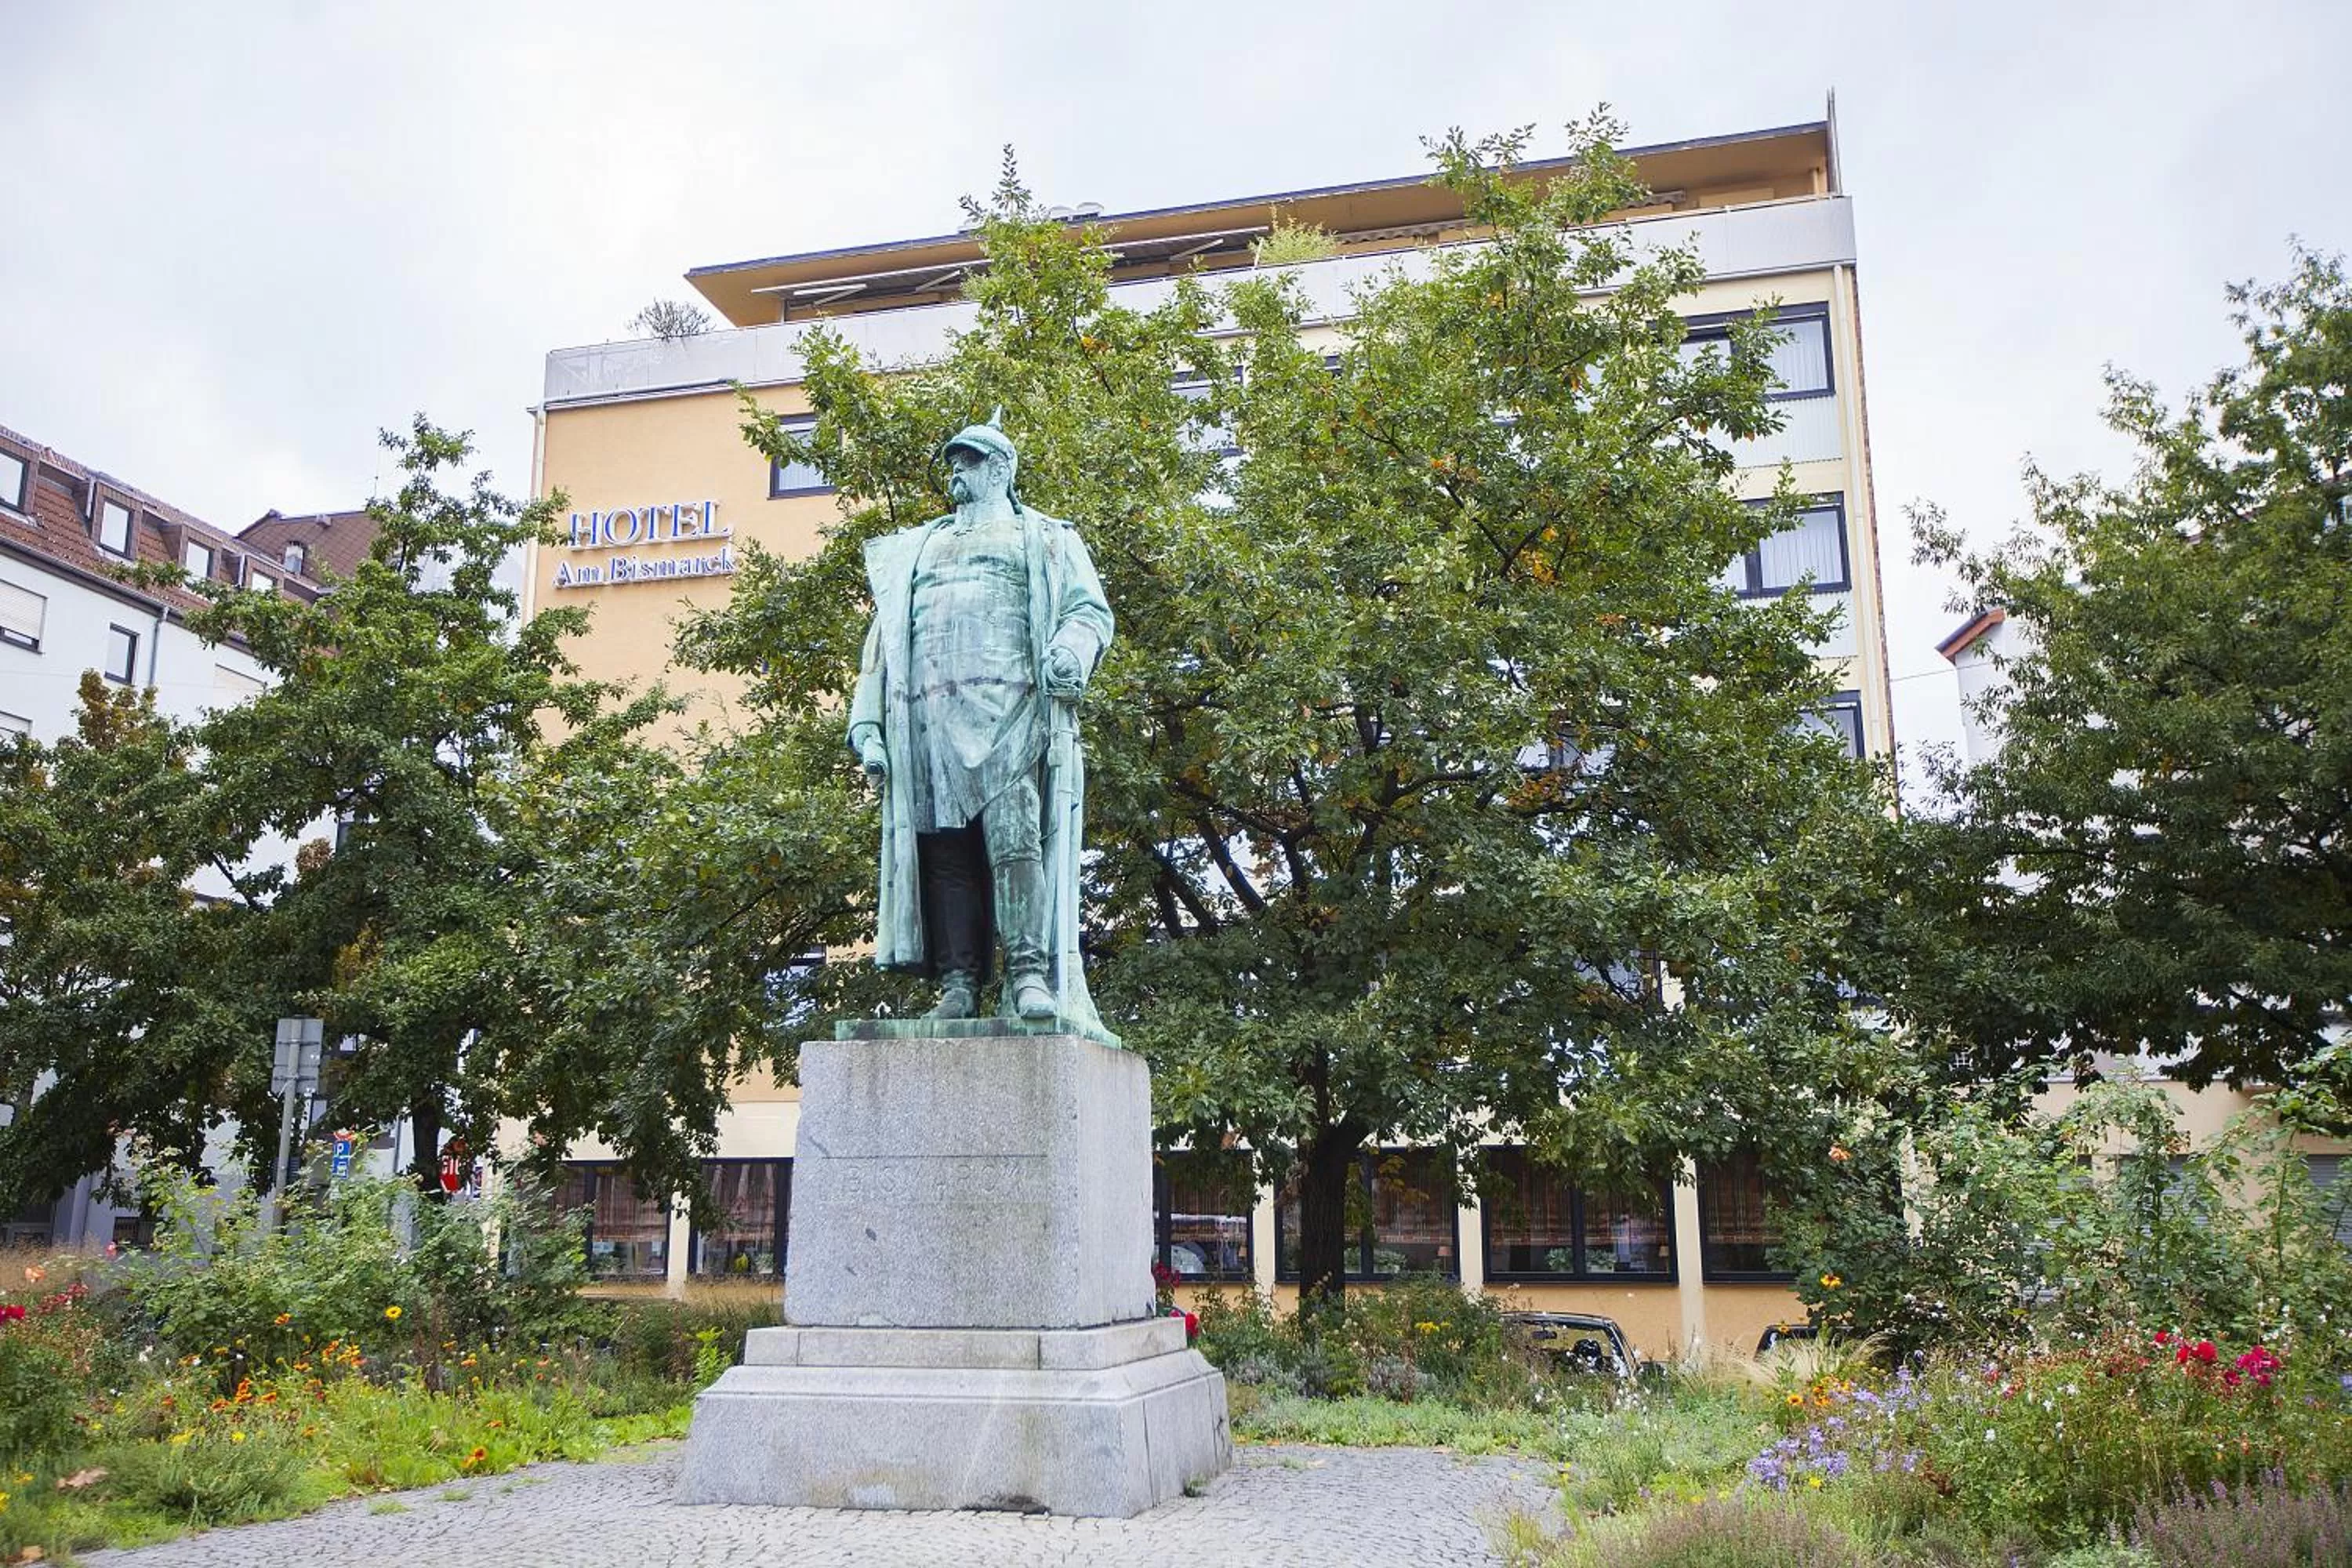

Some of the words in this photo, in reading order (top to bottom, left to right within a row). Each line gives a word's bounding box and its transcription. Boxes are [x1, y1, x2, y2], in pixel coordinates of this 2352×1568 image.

[569, 499, 734, 550] HOTEL
[554, 557, 604, 586] Am
[609, 547, 735, 582] Bismarck
